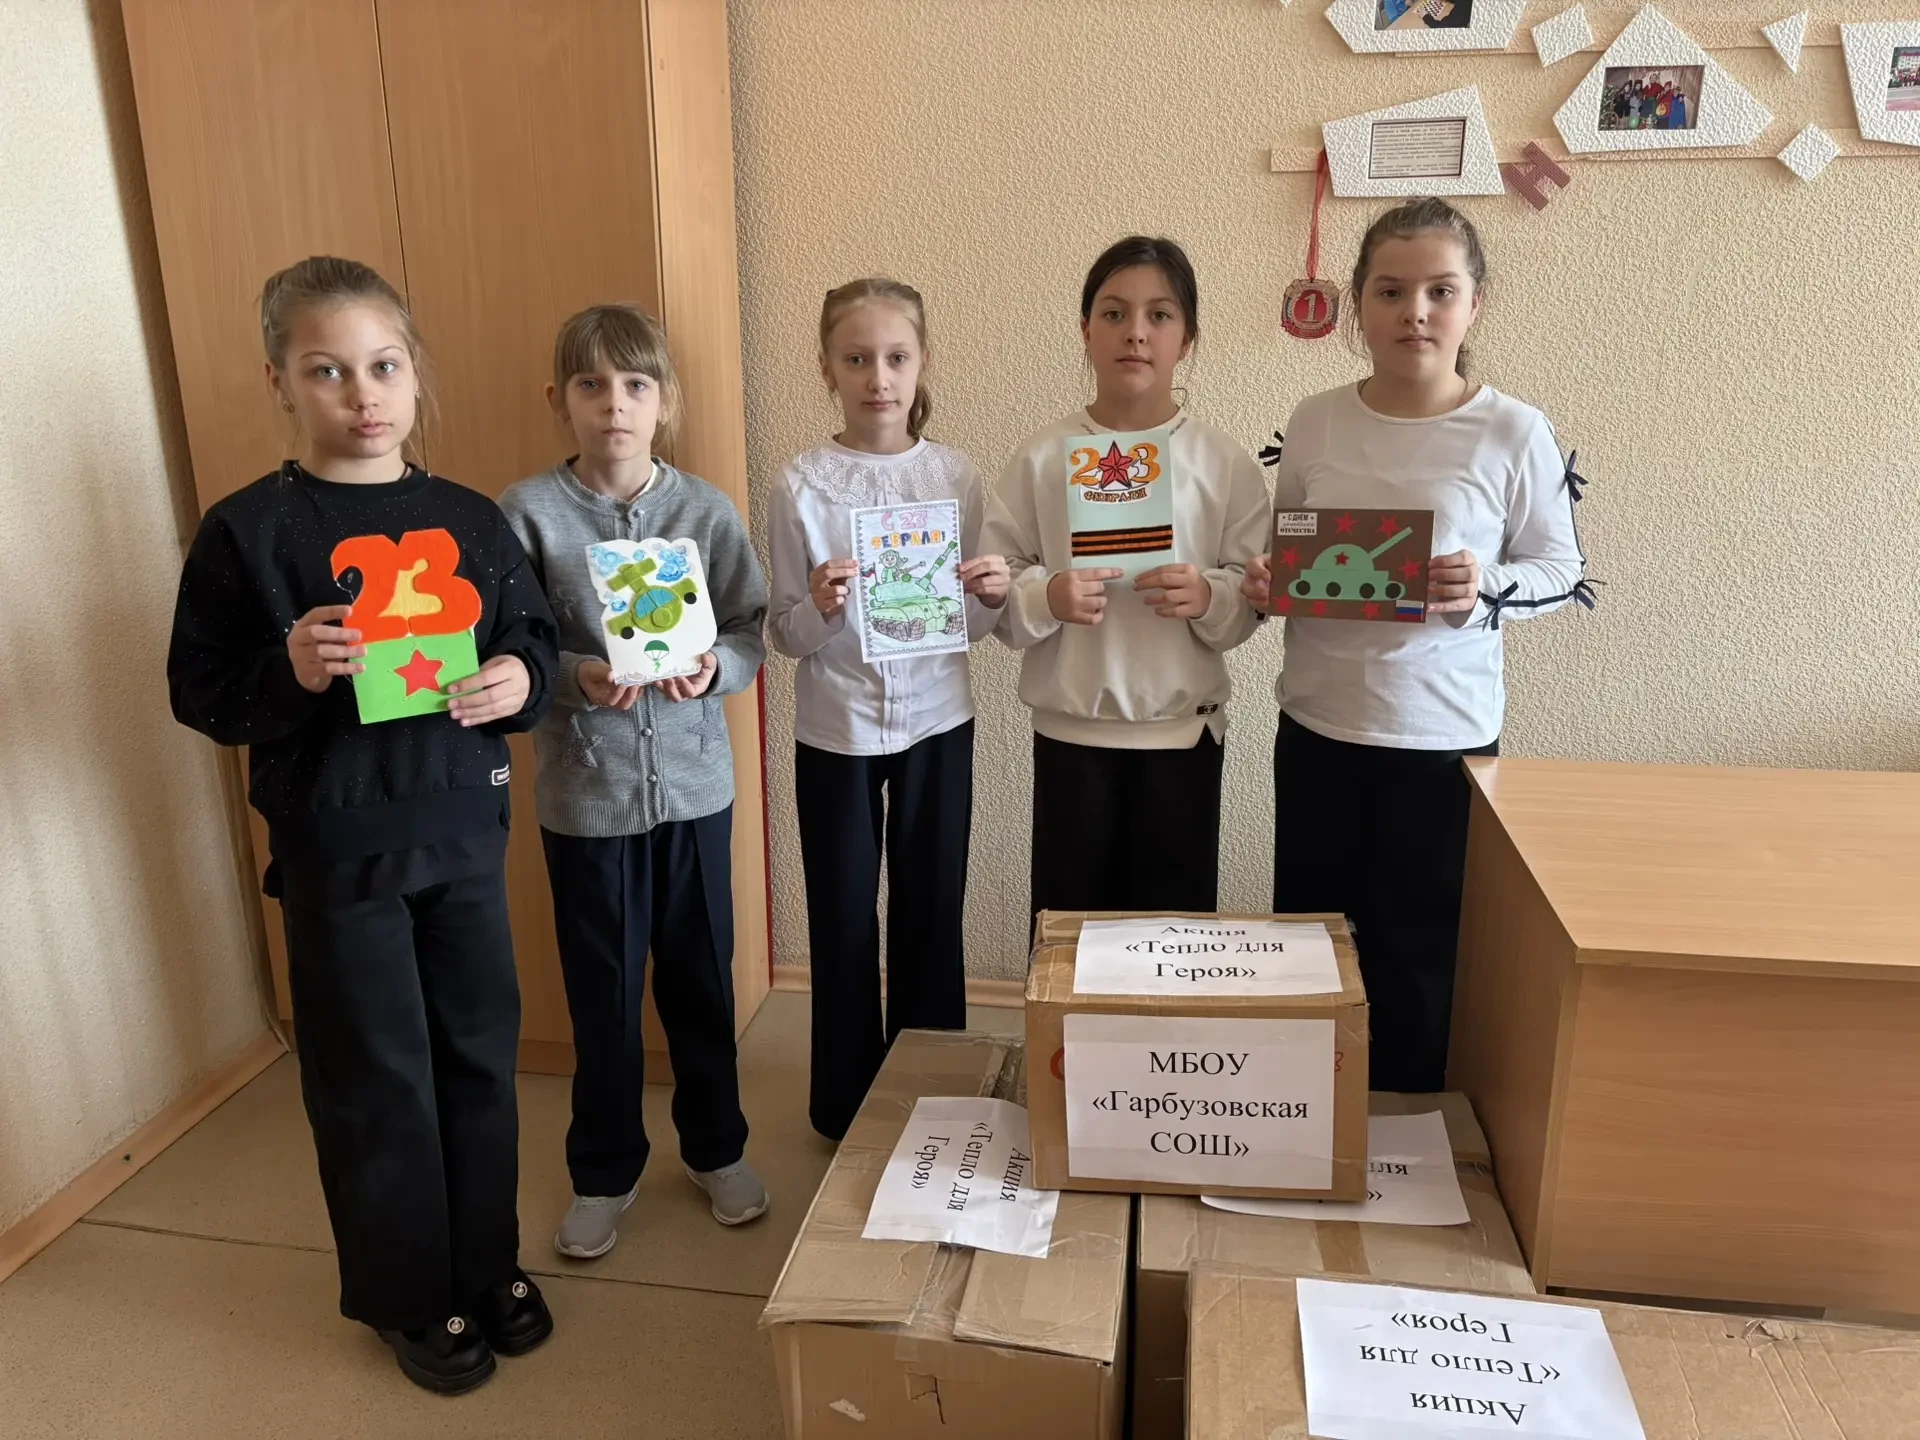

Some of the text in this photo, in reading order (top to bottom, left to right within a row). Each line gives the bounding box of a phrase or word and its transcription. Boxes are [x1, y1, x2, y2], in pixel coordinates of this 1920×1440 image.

[1302, 294, 1320, 322] 1
[1069, 443, 1161, 486] 23
[881, 510, 928, 531] С 23
[330, 528, 482, 645] 23
[1161, 926, 1247, 937] Акция
[1125, 940, 1284, 955] «Тепло для
[1155, 963, 1257, 981] Героя»
[1148, 1051, 1250, 1076] МБОУ
[1092, 1090, 1309, 1121] «Гарбузовская
[1150, 1131, 1250, 1158] СОШ»
[911, 1135, 950, 1189] Героя»
[947, 1122, 993, 1212] «Тепло для
[1000, 1147, 1031, 1202] Акция
[1391, 1312, 1515, 1343] Героя»
[1359, 1345, 1561, 1384] «Тепло для
[1409, 1392, 1527, 1426] Акция
